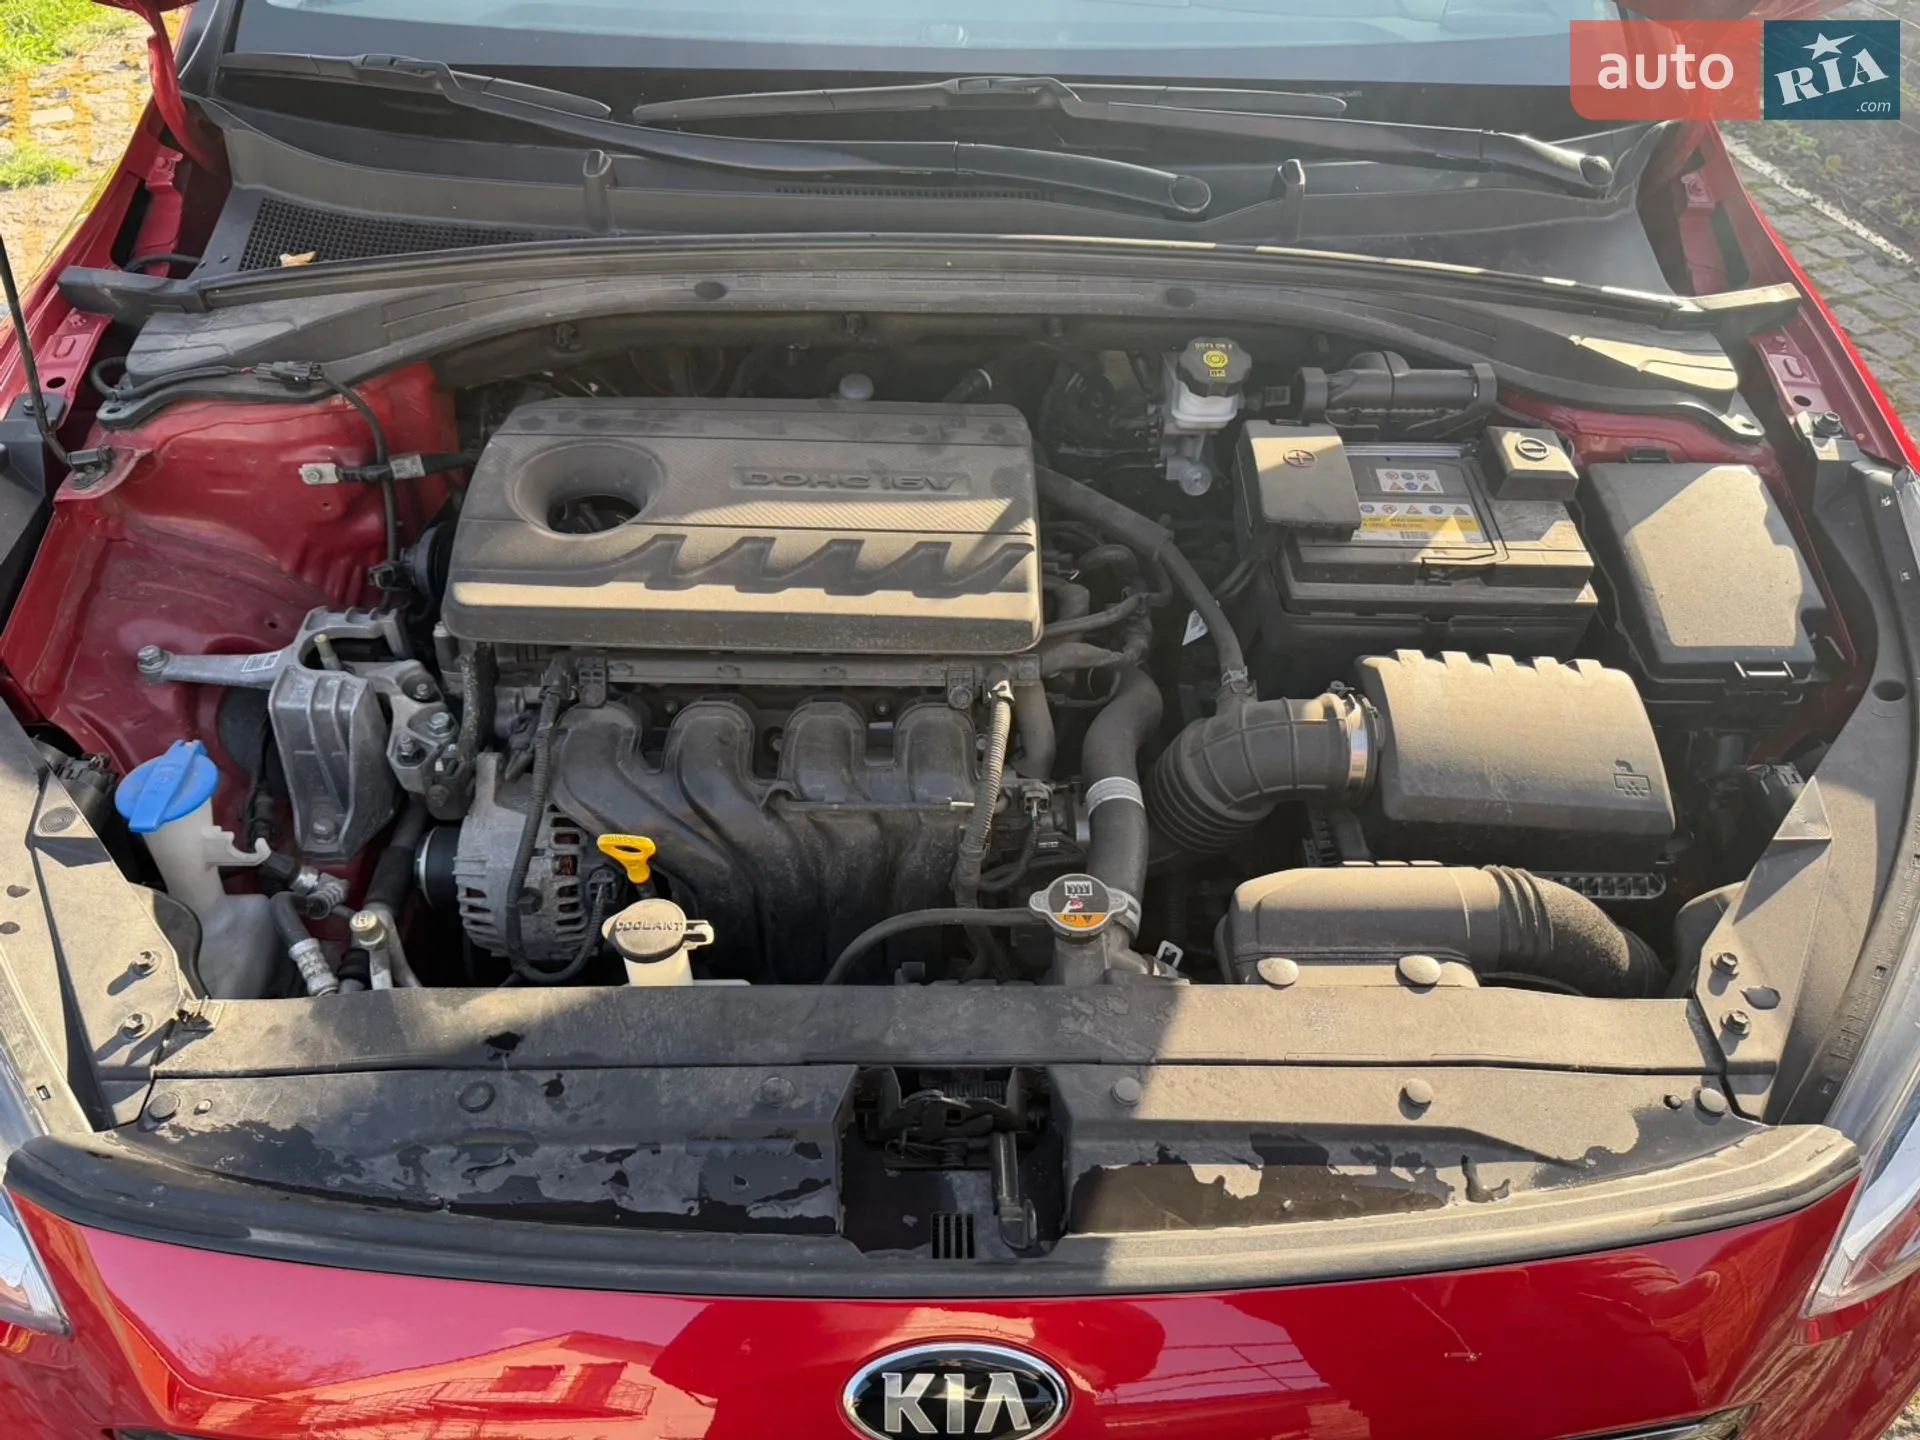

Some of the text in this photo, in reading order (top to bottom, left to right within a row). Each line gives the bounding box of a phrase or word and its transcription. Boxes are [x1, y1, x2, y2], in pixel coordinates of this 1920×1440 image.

[742, 471, 956, 491] DOHC 16V
[614, 920, 683, 932] COOLANT
[882, 1371, 1032, 1435] KIA
